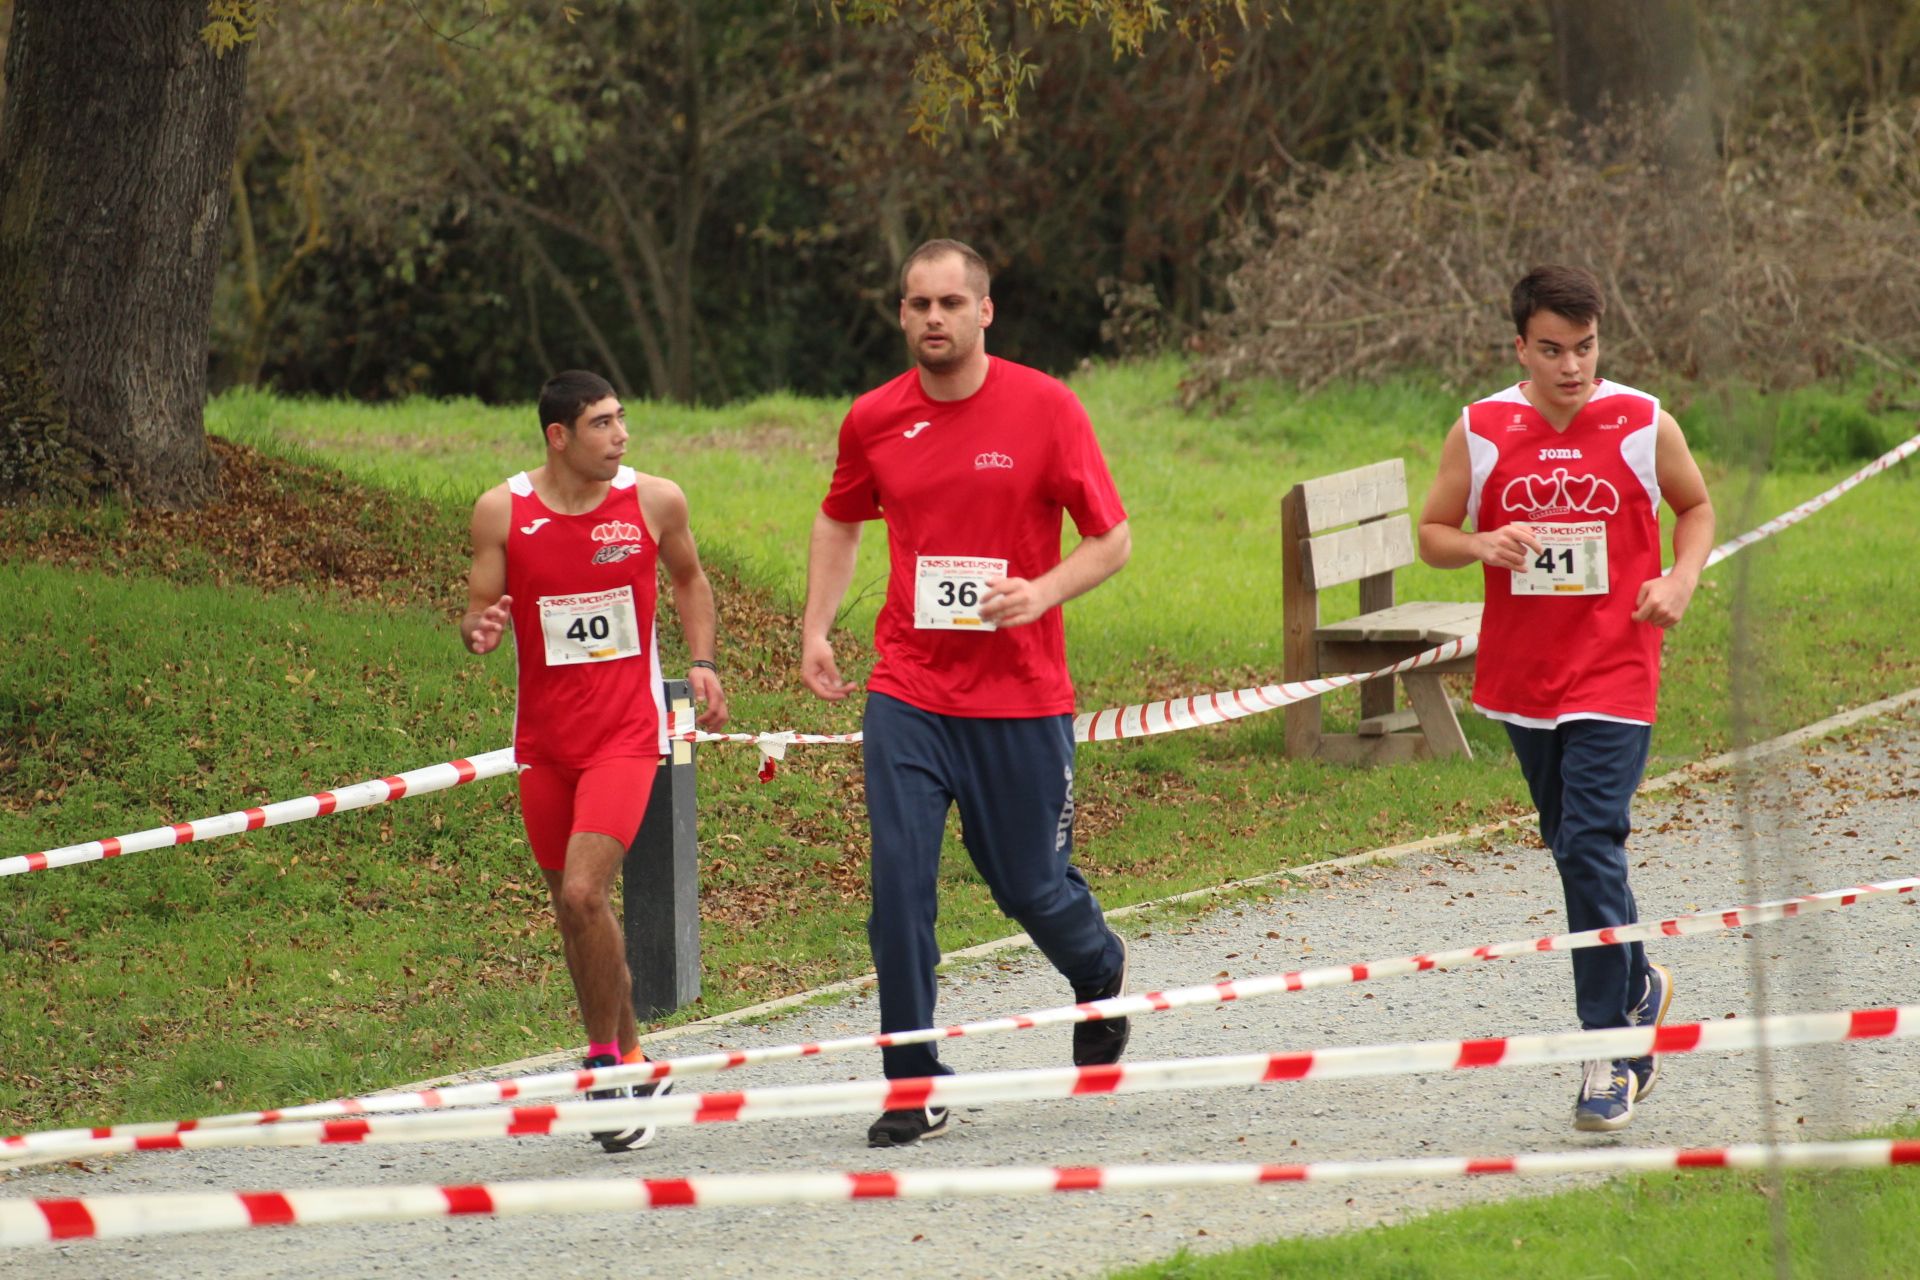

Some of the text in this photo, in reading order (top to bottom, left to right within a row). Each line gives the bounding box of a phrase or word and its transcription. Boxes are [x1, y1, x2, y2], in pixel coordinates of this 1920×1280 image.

[1534, 547, 1574, 574] 41
[937, 580, 979, 608] 36
[566, 614, 610, 643] 40
